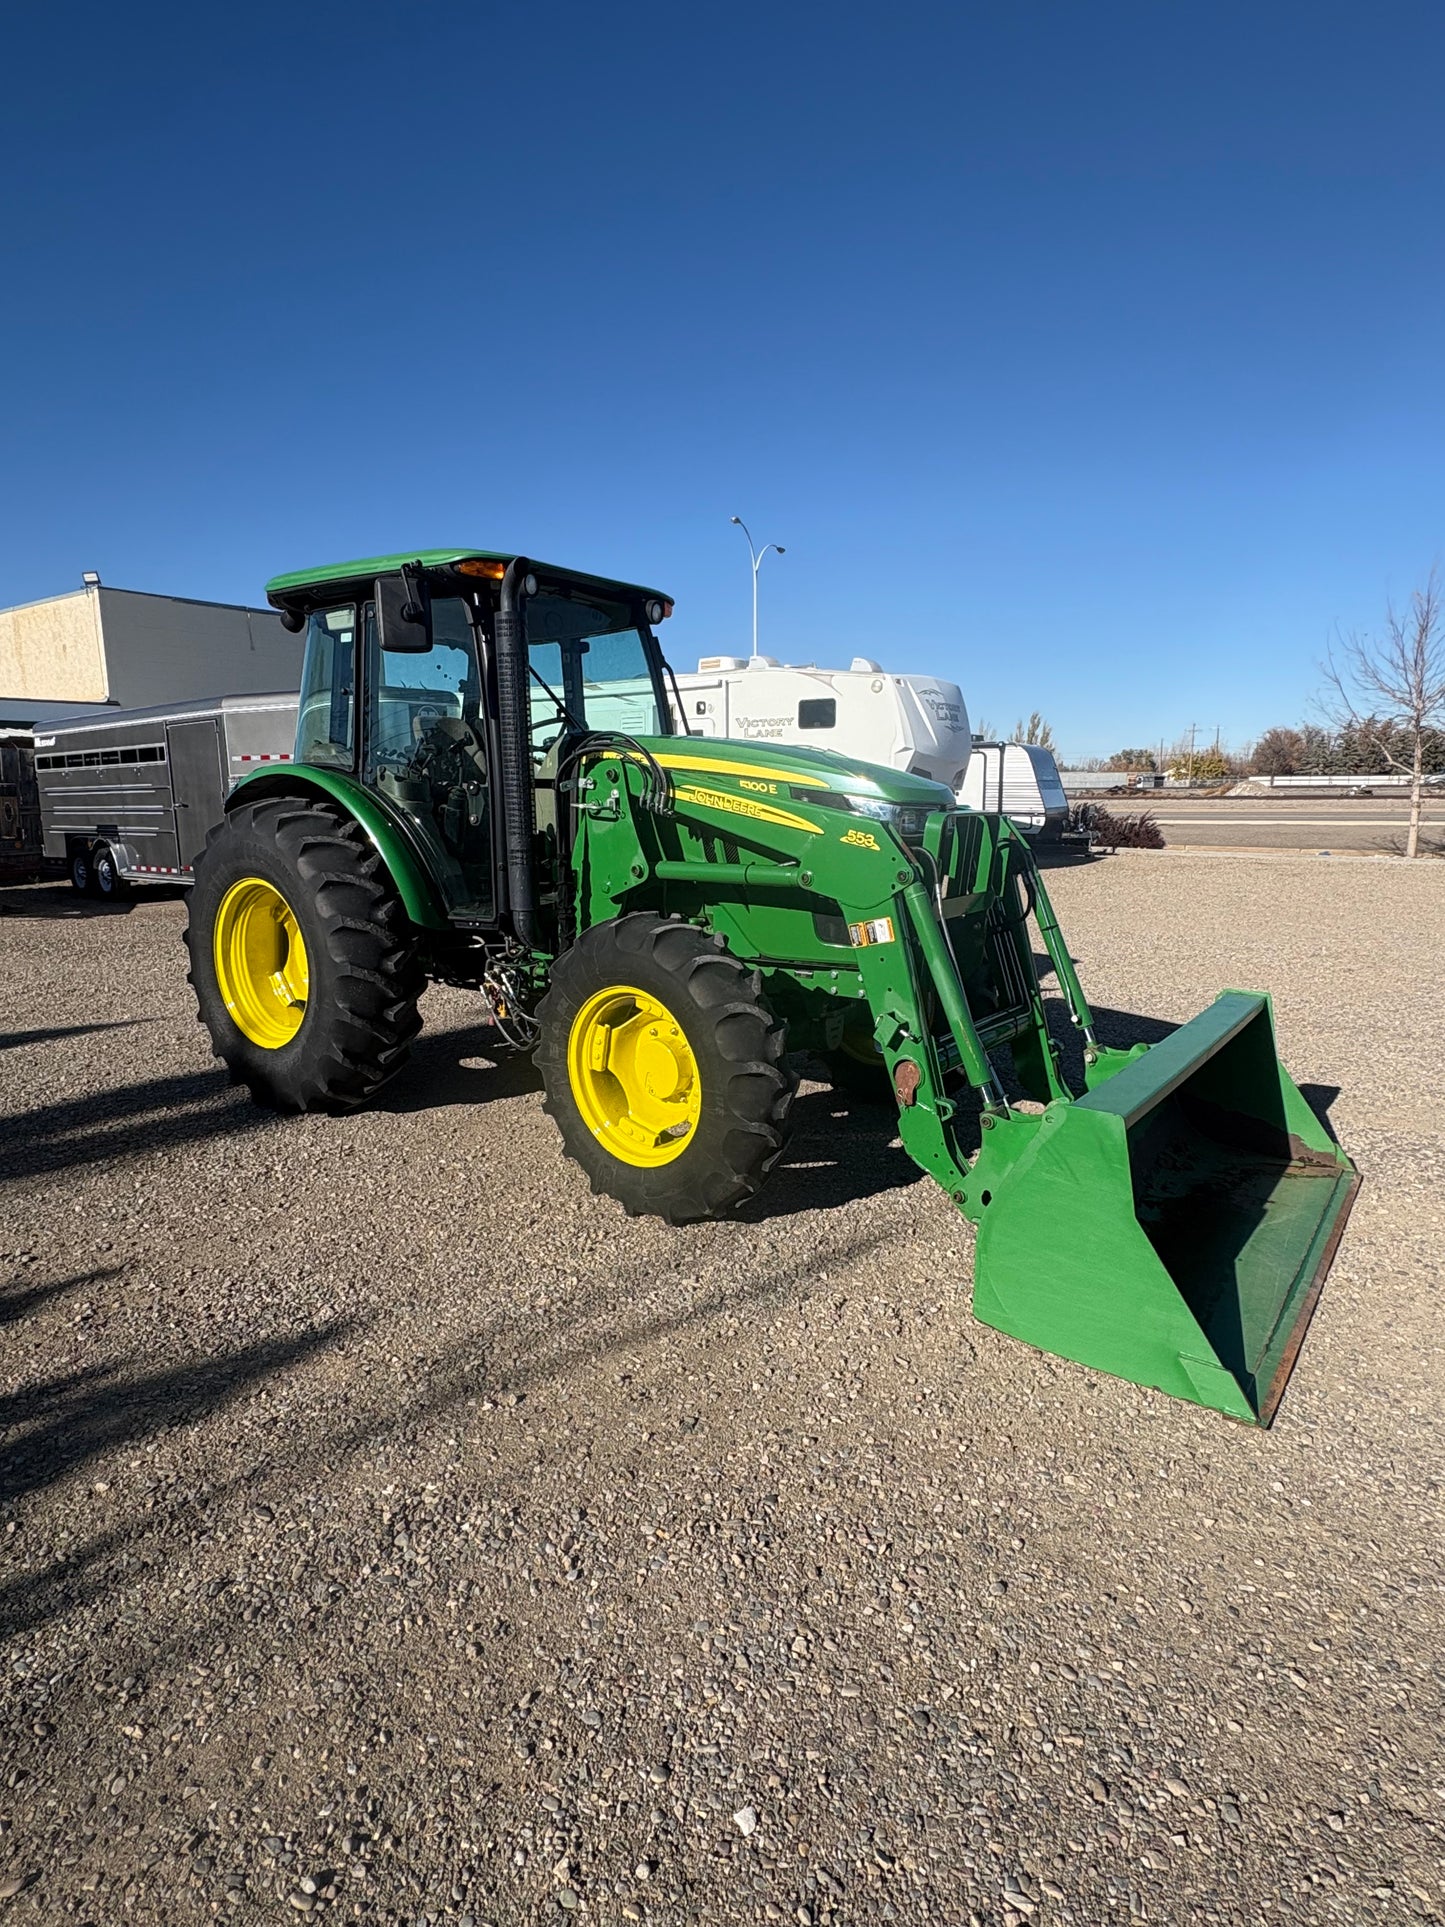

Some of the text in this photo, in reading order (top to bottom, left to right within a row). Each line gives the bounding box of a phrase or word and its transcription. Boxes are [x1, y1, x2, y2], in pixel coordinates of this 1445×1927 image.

[735, 717, 795, 728] VICTORY
[743, 728, 783, 738] LANE
[769, 784, 778, 794] E
[689, 789, 761, 817] JOHN DEERE
[847, 829, 875, 847] 553
